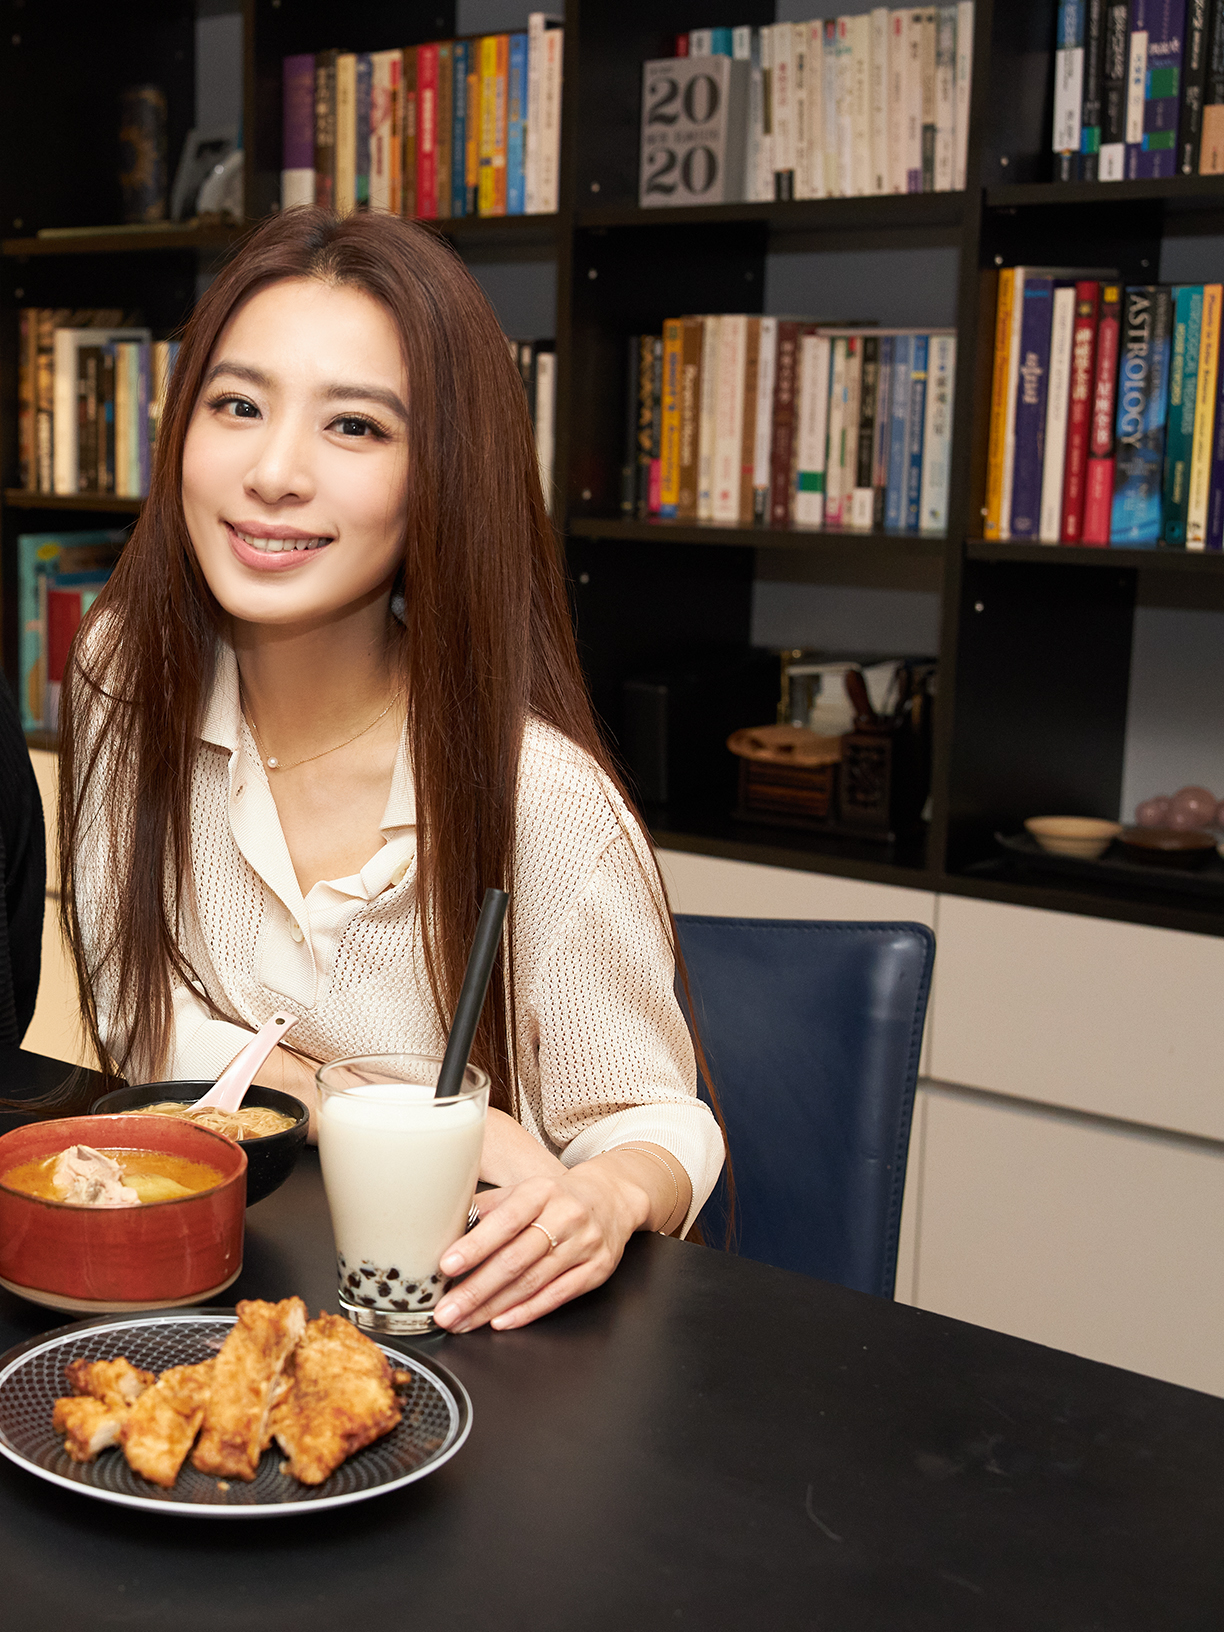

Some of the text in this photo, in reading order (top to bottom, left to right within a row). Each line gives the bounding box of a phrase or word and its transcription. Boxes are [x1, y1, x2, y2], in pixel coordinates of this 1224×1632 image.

[648, 74, 719, 124] 20
[646, 146, 717, 194] 20
[1121, 294, 1151, 448] ASTROLOGY
